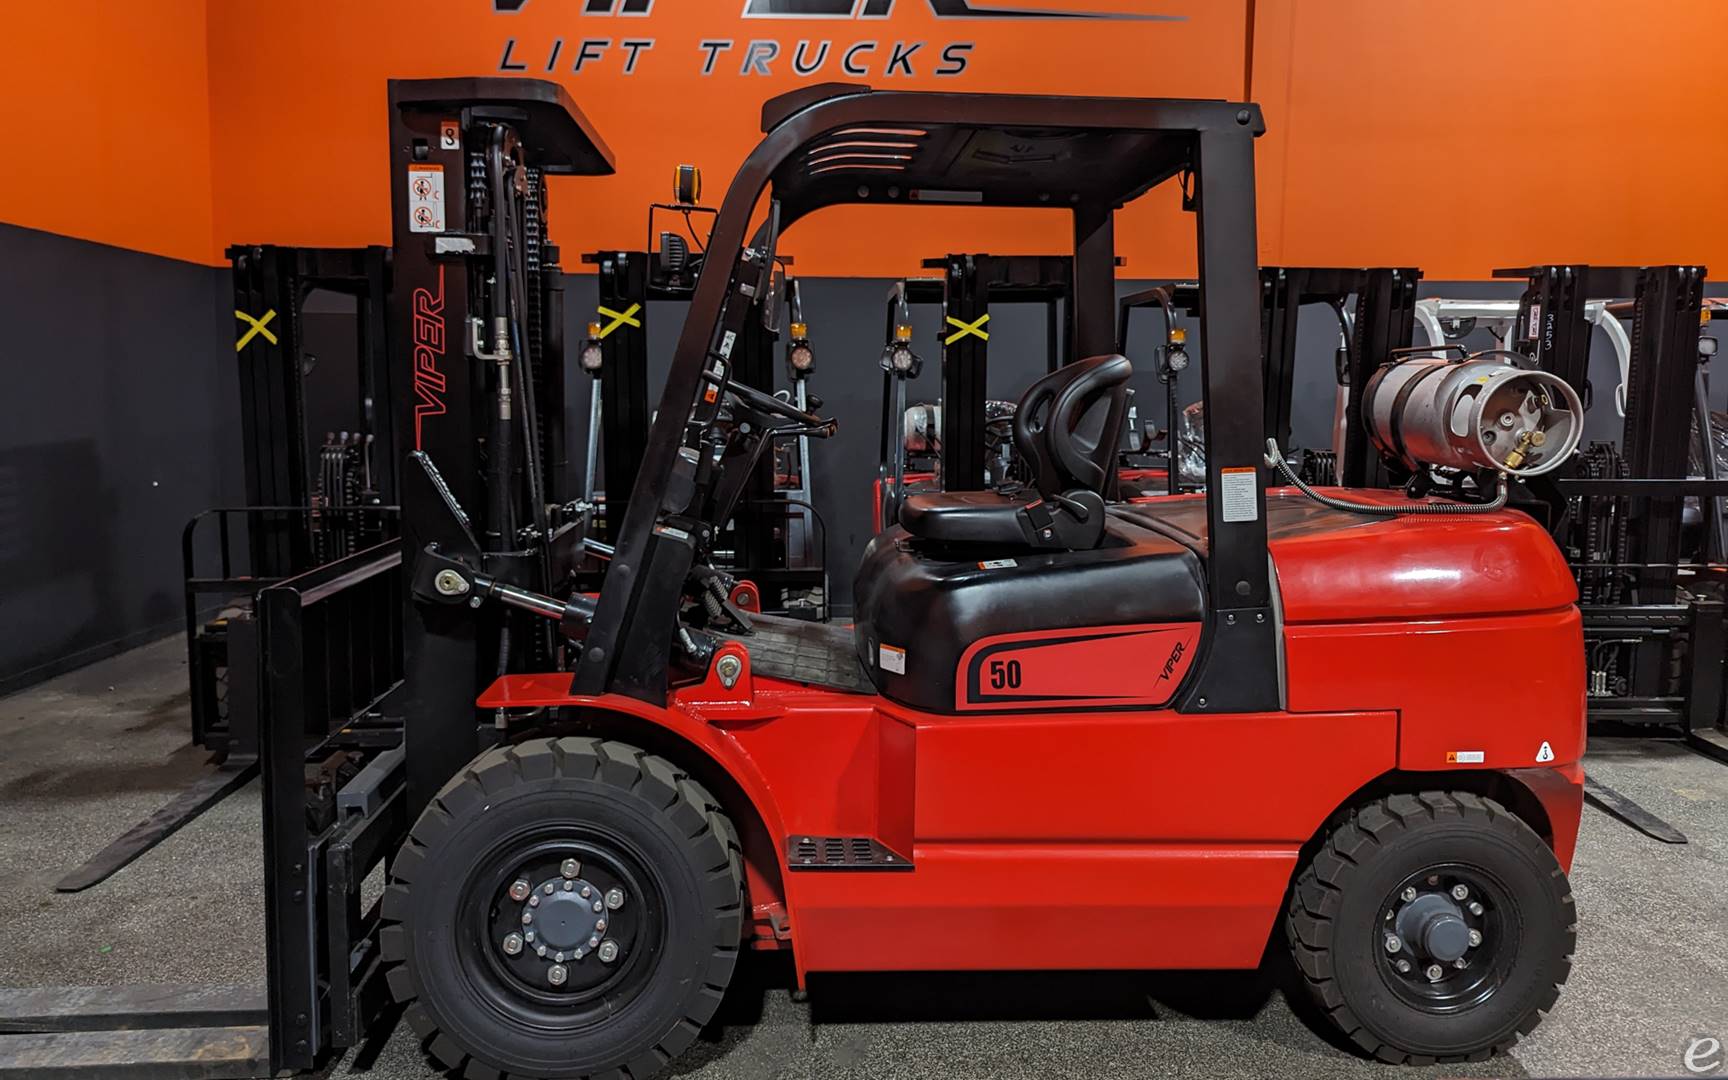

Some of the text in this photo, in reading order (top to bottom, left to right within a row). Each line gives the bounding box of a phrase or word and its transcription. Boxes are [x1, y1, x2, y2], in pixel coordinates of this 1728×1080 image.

[498, 38, 976, 76] LIFT TRUCKS
[413, 264, 446, 450] VIPER
[990, 660, 1021, 689] 50
[1157, 638, 1188, 684] VIPER
